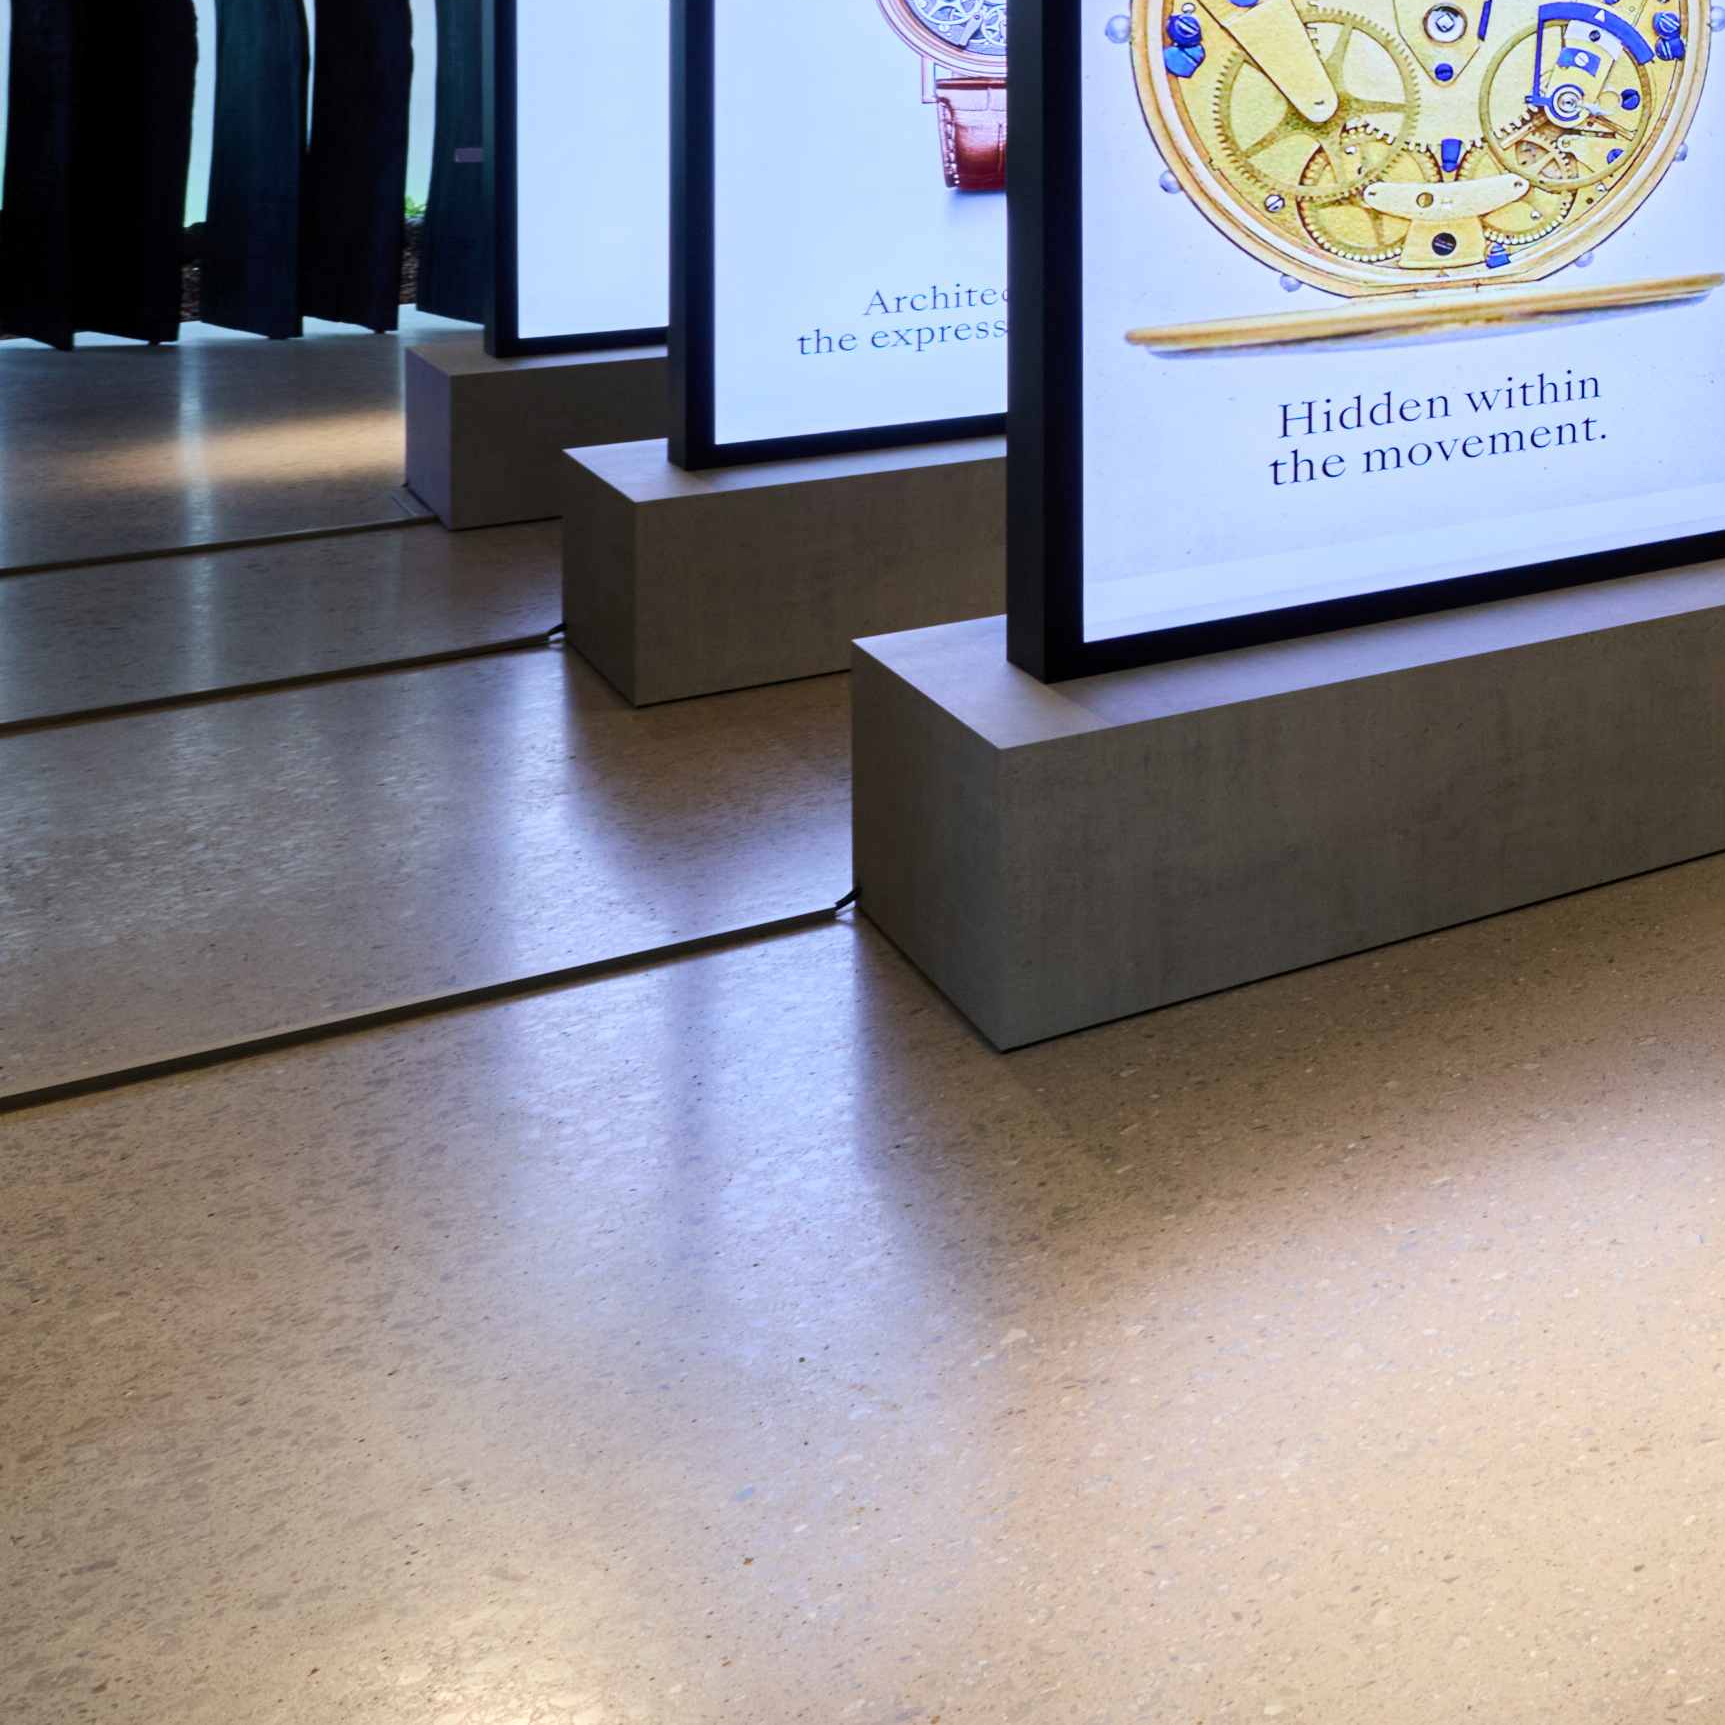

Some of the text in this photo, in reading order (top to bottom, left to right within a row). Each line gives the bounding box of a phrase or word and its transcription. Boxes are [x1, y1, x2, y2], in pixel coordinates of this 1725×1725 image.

[797, 328, 857, 355] the
[1278, 369, 1602, 439] Hidden within
[1268, 416, 1607, 486] the movement.
